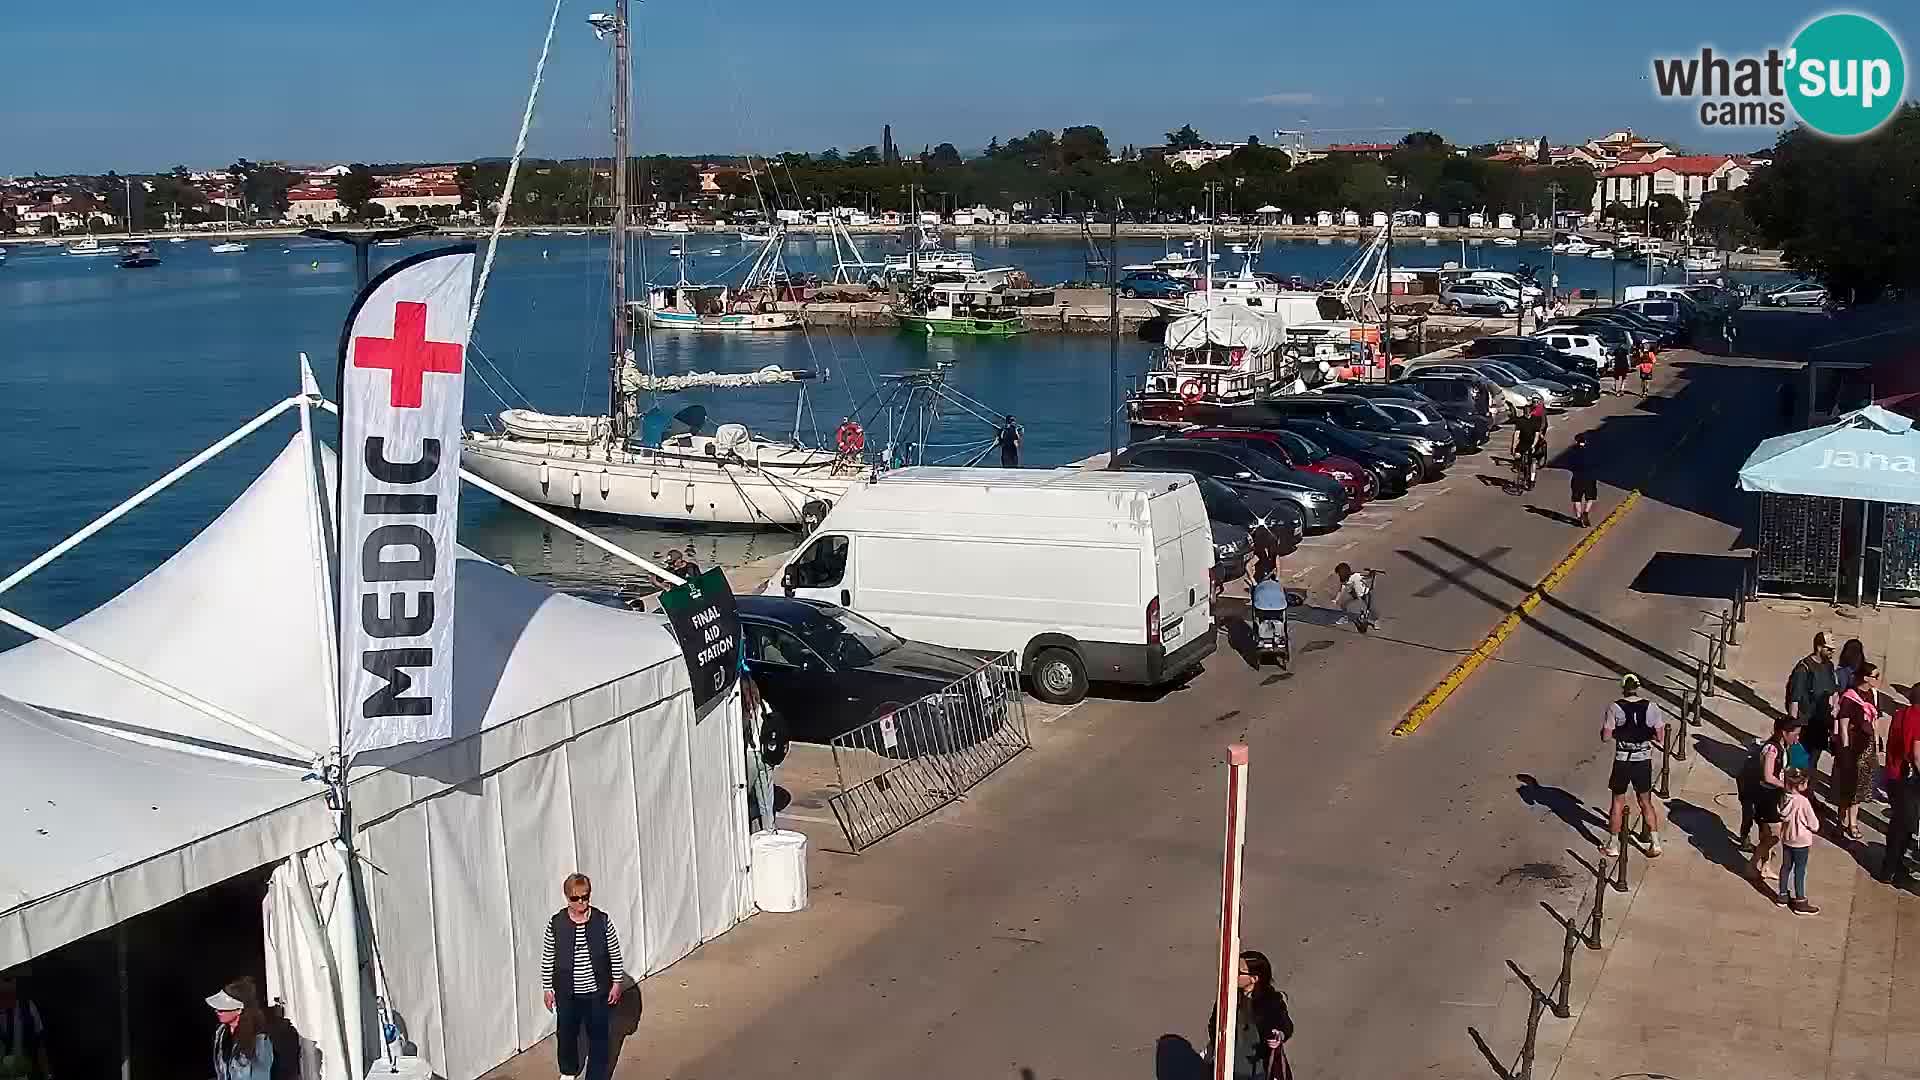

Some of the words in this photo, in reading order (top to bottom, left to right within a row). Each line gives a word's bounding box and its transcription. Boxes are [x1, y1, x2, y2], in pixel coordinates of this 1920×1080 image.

[362, 436, 441, 719] MEDIC
[691, 605, 721, 630] FINAL
[704, 624, 720, 644] AID
[697, 635, 734, 667] STATION
